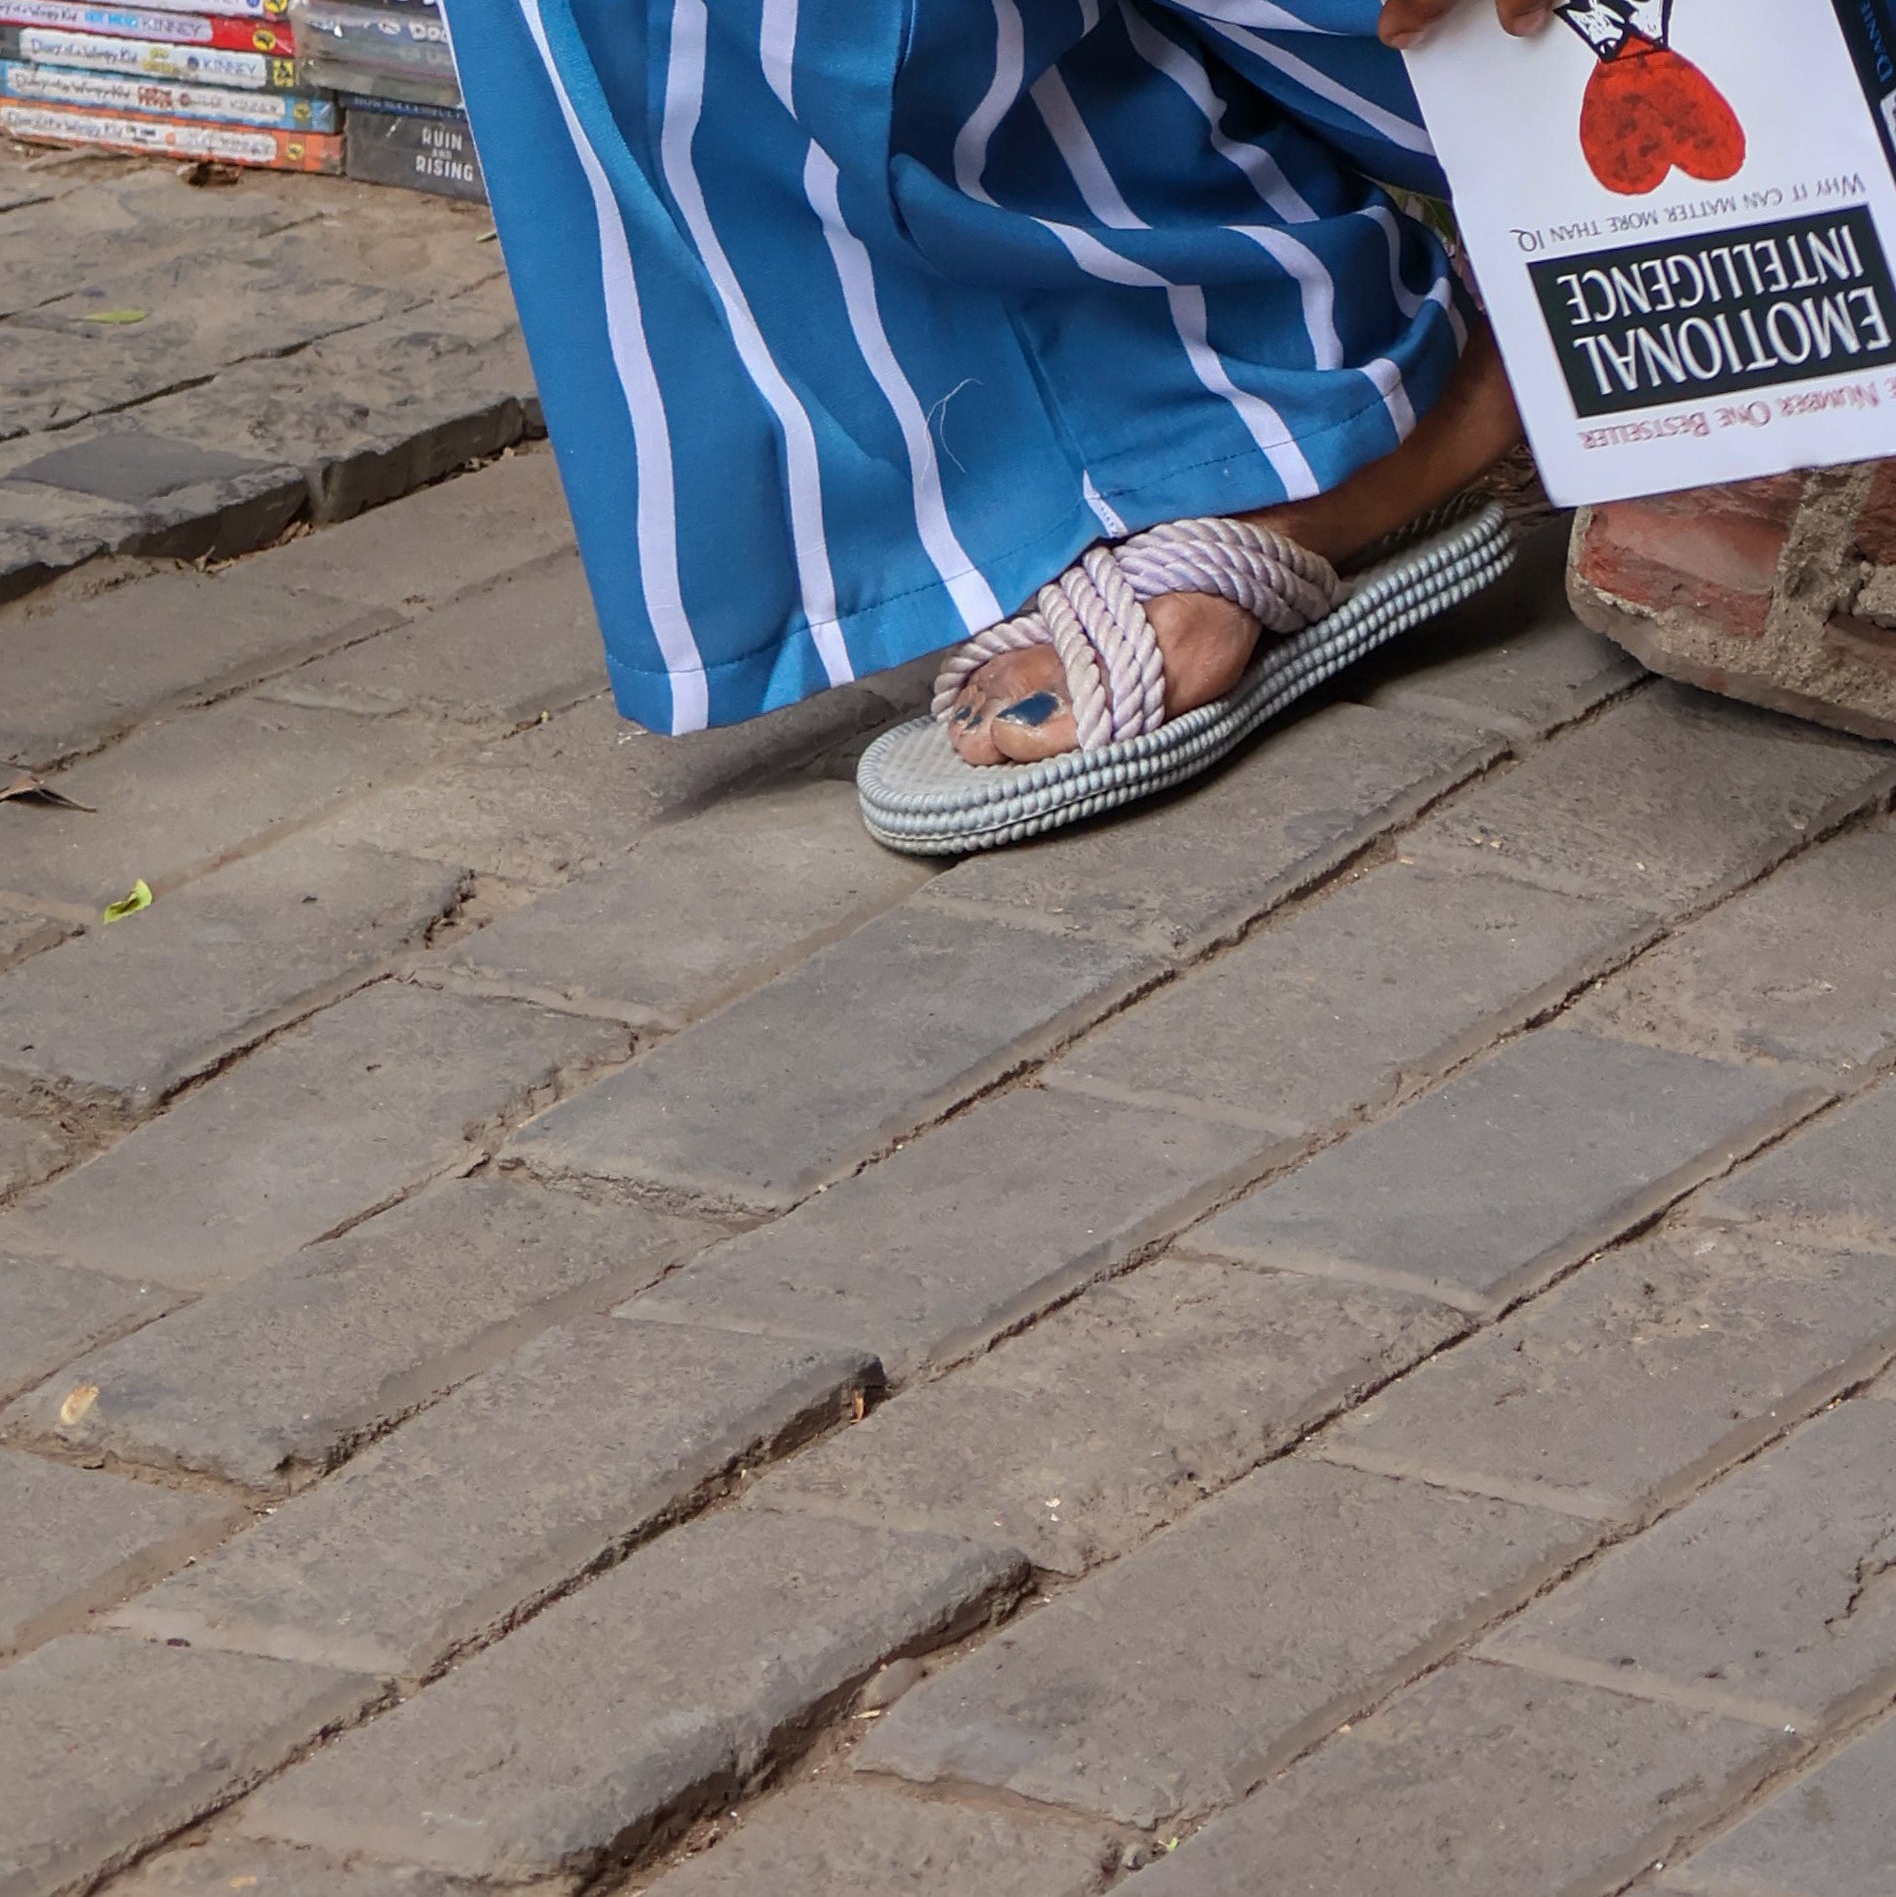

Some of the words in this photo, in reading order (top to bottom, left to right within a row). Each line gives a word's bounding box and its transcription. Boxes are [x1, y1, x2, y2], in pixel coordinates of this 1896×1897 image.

[421, 128, 464, 153] RUIN
[414, 154, 475, 184] RISING
[1737, 186, 1785, 210] CAN
[1791, 183, 1810, 203] IT
[1816, 171, 1867, 198] WHY
[1608, 207, 1662, 234] MORE
[1665, 194, 1738, 224] MATTER
[1508, 227, 1547, 254] IQ
[1548, 218, 1602, 245] THAN
[1556, 224, 1866, 327] INTELLIGENCE
[1572, 285, 1893, 396] EMOTIONAL
